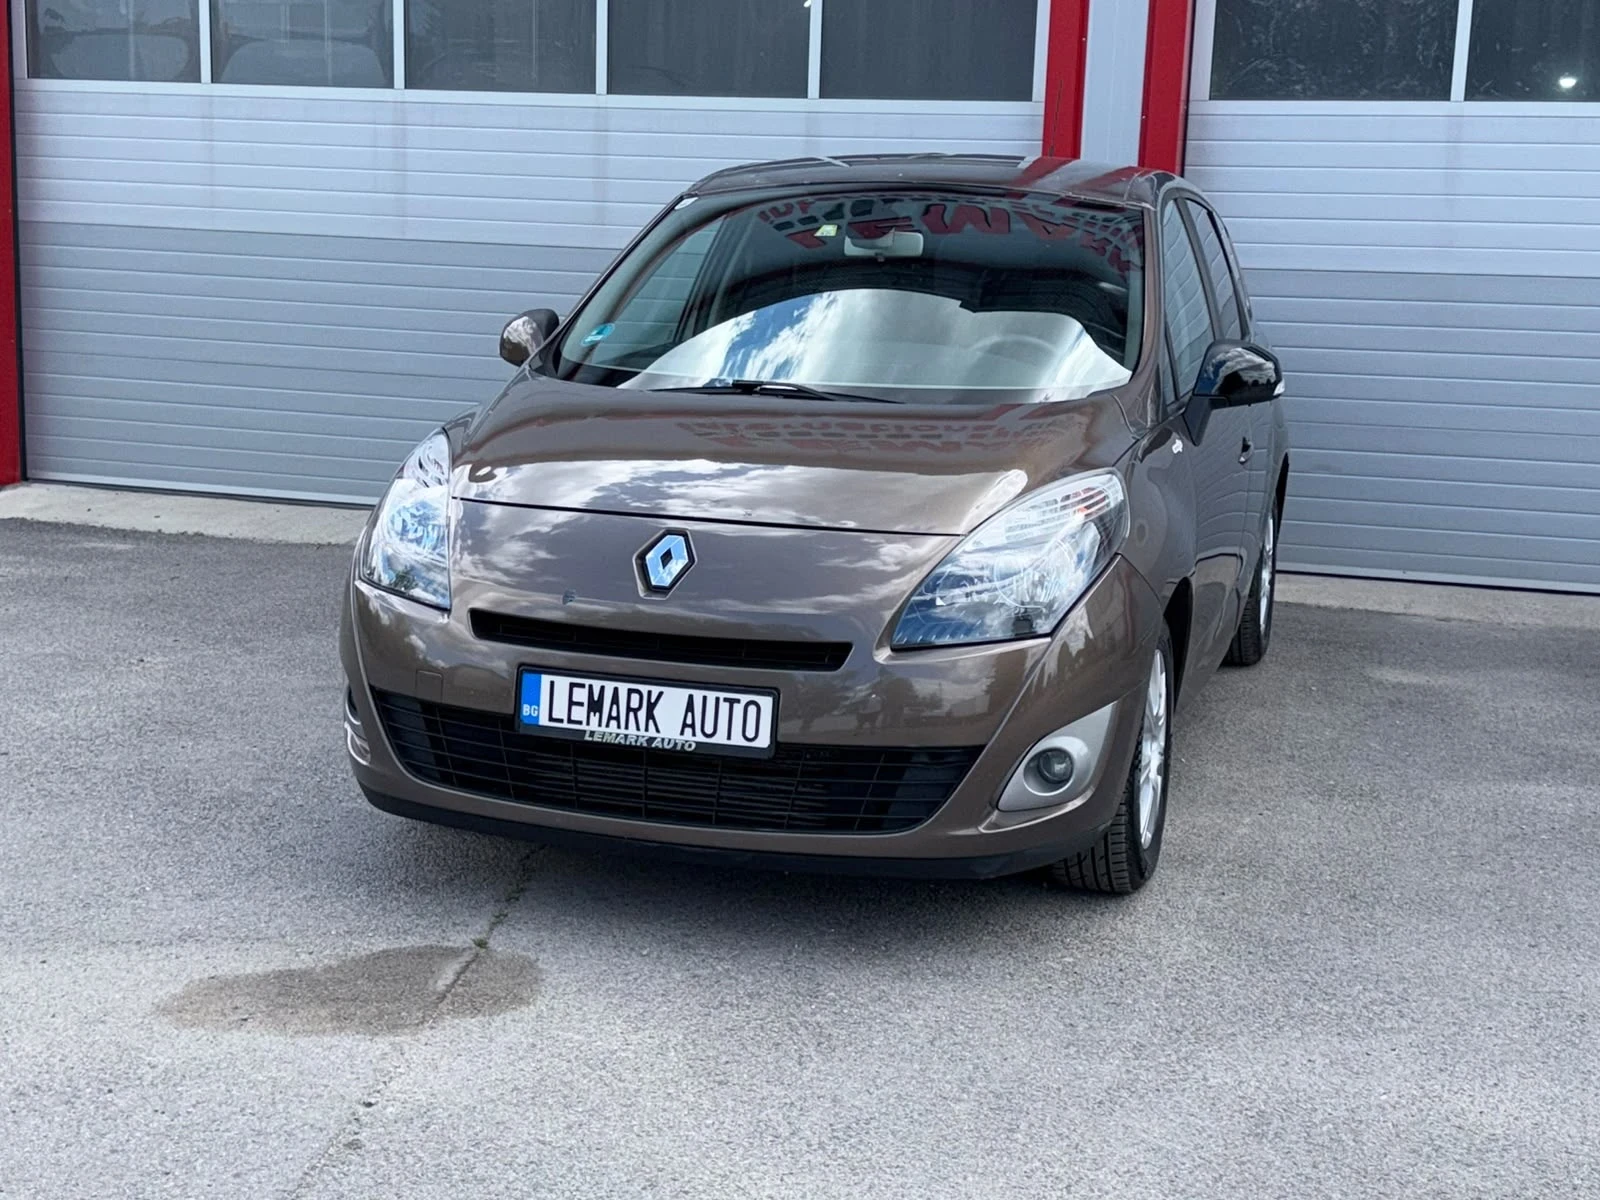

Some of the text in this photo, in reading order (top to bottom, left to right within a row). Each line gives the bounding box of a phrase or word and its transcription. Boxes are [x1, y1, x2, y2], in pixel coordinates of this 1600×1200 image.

[522, 703, 539, 717] BG
[548, 679, 762, 743] LEMARK AUTO
[583, 729, 697, 752] LEMARK AUTO
